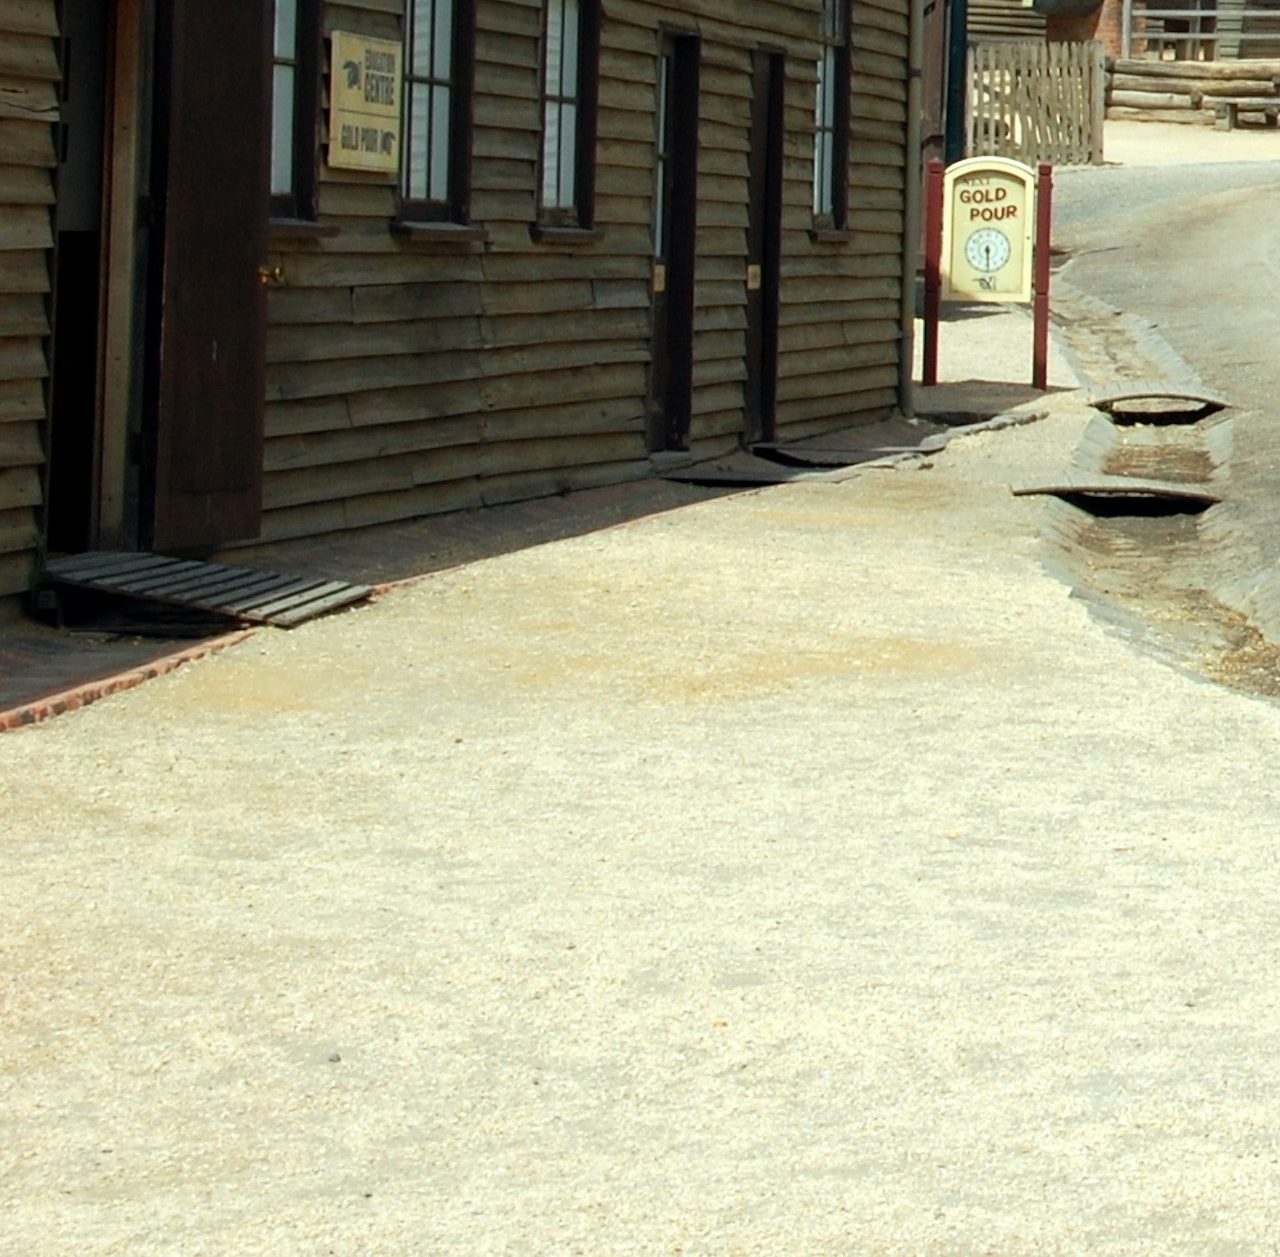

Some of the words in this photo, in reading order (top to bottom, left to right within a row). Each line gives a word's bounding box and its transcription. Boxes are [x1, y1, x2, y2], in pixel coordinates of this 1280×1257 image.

[364, 73, 394, 105] CENTRE
[341, 124, 359, 151] GOLD
[361, 127, 378, 154] POUR
[960, 188, 1007, 204] GOLD
[970, 205, 1018, 221] POUR
